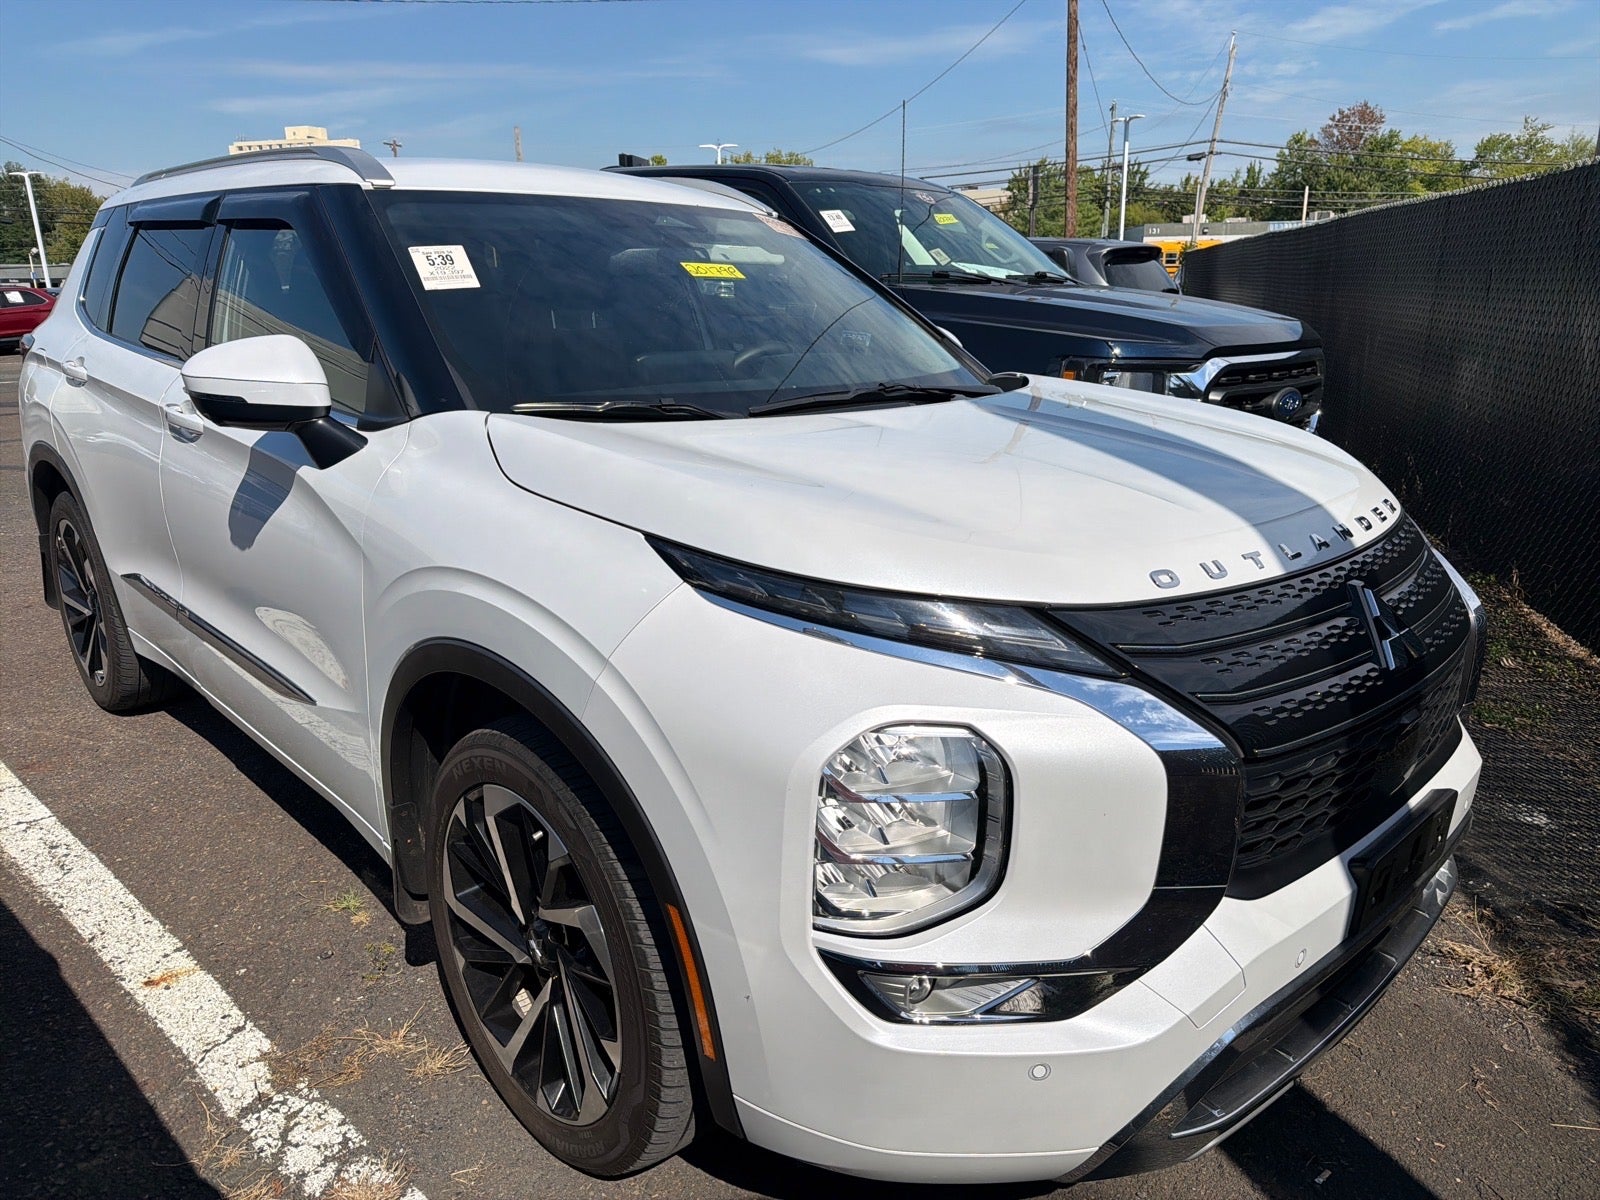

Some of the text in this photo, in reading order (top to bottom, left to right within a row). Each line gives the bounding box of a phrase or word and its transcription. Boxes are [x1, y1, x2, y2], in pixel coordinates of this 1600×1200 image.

[1149, 227, 1160, 235] 131
[425, 254, 455, 266] 5:39
[1149, 498, 1397, 590] OUTLANDER
[452, 756, 507, 781] NEXEN
